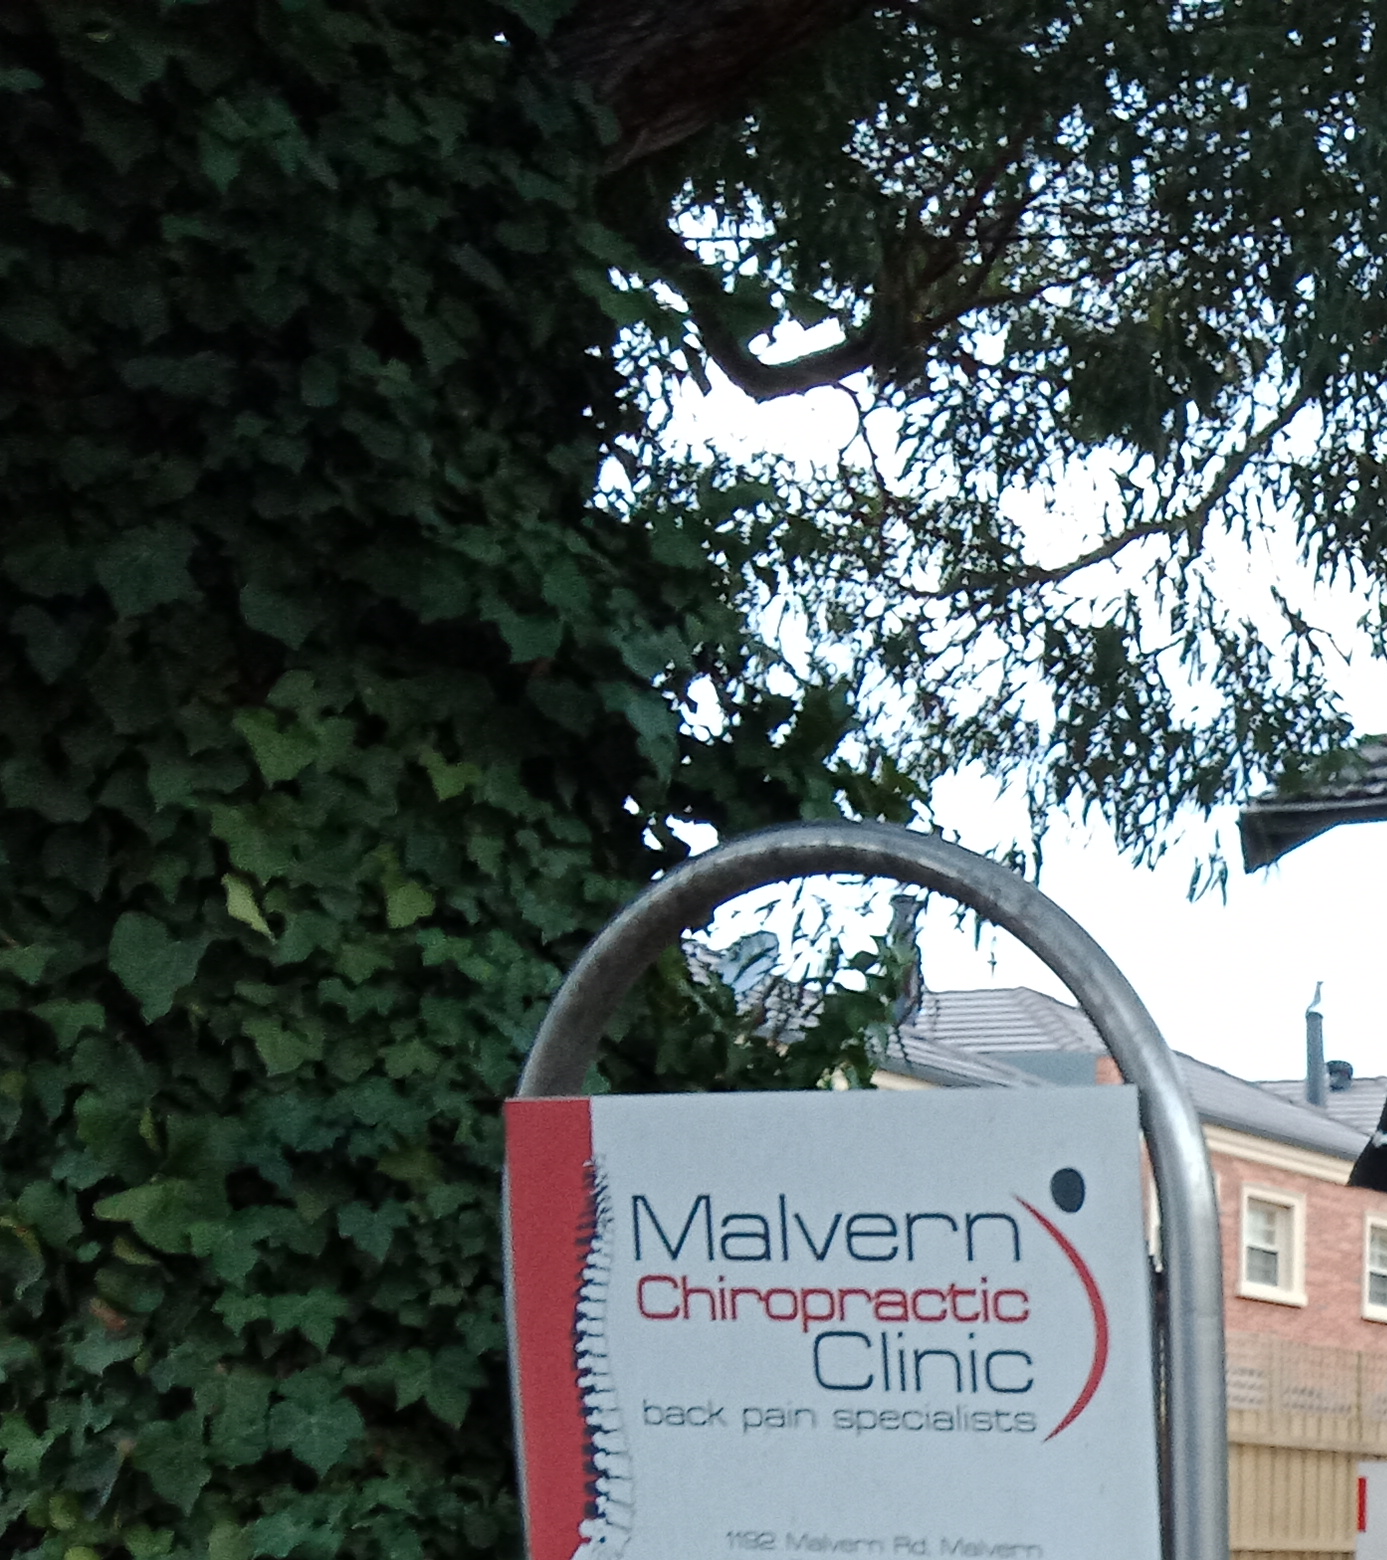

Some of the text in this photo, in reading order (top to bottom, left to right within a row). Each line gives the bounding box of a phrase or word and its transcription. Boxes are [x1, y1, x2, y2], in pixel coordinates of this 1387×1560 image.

[631, 1193, 1021, 1263] Malvern
[636, 1274, 1030, 1333] Chiropractic
[812, 1330, 1035, 1395] Clinic
[643, 1399, 1038, 1437] back pain specialists
[785, 1532, 885, 1554] Malvern
[940, 1537, 1044, 1560] Malvern
